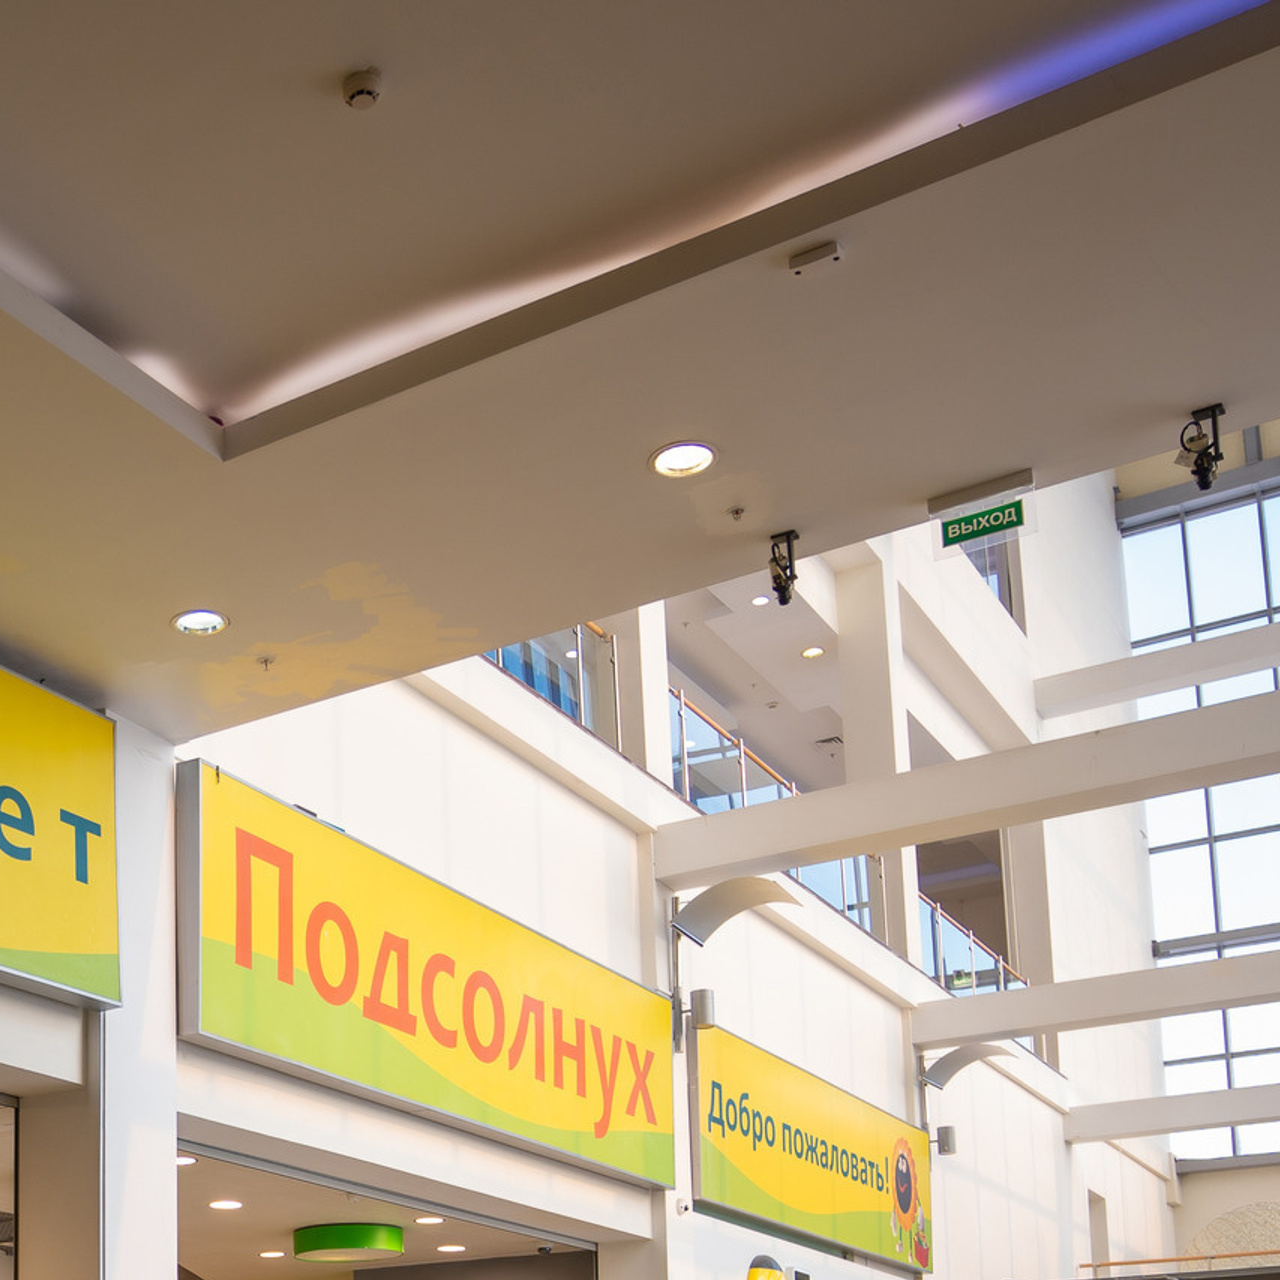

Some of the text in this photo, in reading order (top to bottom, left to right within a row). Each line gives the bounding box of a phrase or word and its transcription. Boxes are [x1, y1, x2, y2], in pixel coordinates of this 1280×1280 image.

[948, 507, 1017, 539] ВЫХОД
[235, 826, 657, 1139] Подсолнух
[708, 1080, 889, 1195] Добро пожаловать!
